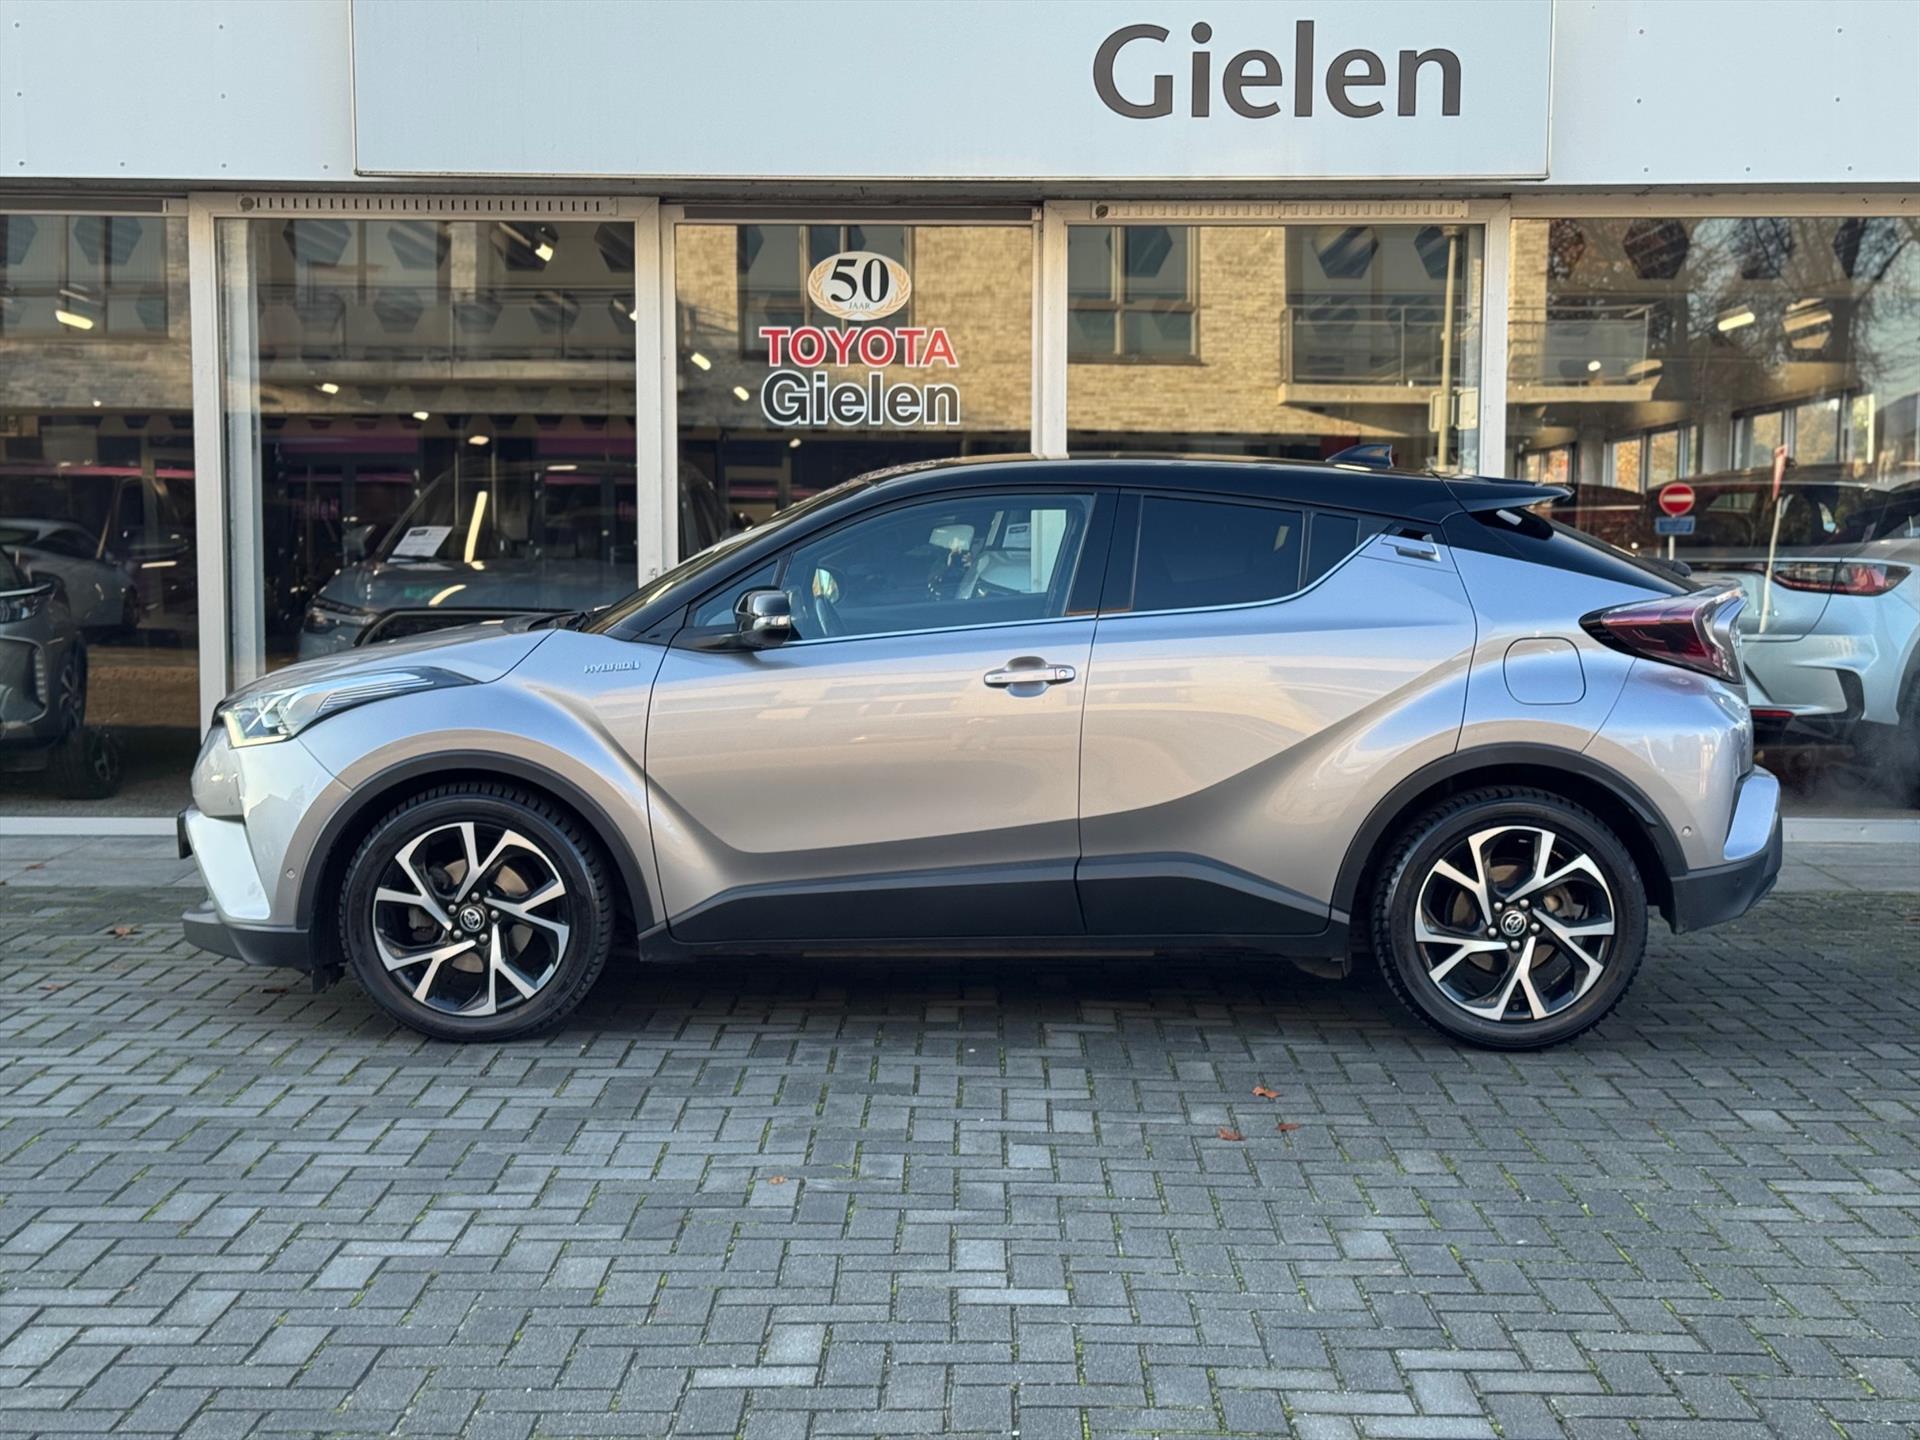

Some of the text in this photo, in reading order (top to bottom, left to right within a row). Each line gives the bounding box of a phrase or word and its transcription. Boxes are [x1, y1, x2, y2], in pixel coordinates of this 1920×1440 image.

[1092, 19, 1462, 120] Gielen
[829, 257, 890, 303] 50
[848, 301, 871, 310] JAAR
[759, 327, 959, 367] TOYOTA
[761, 370, 960, 425] Gielen
